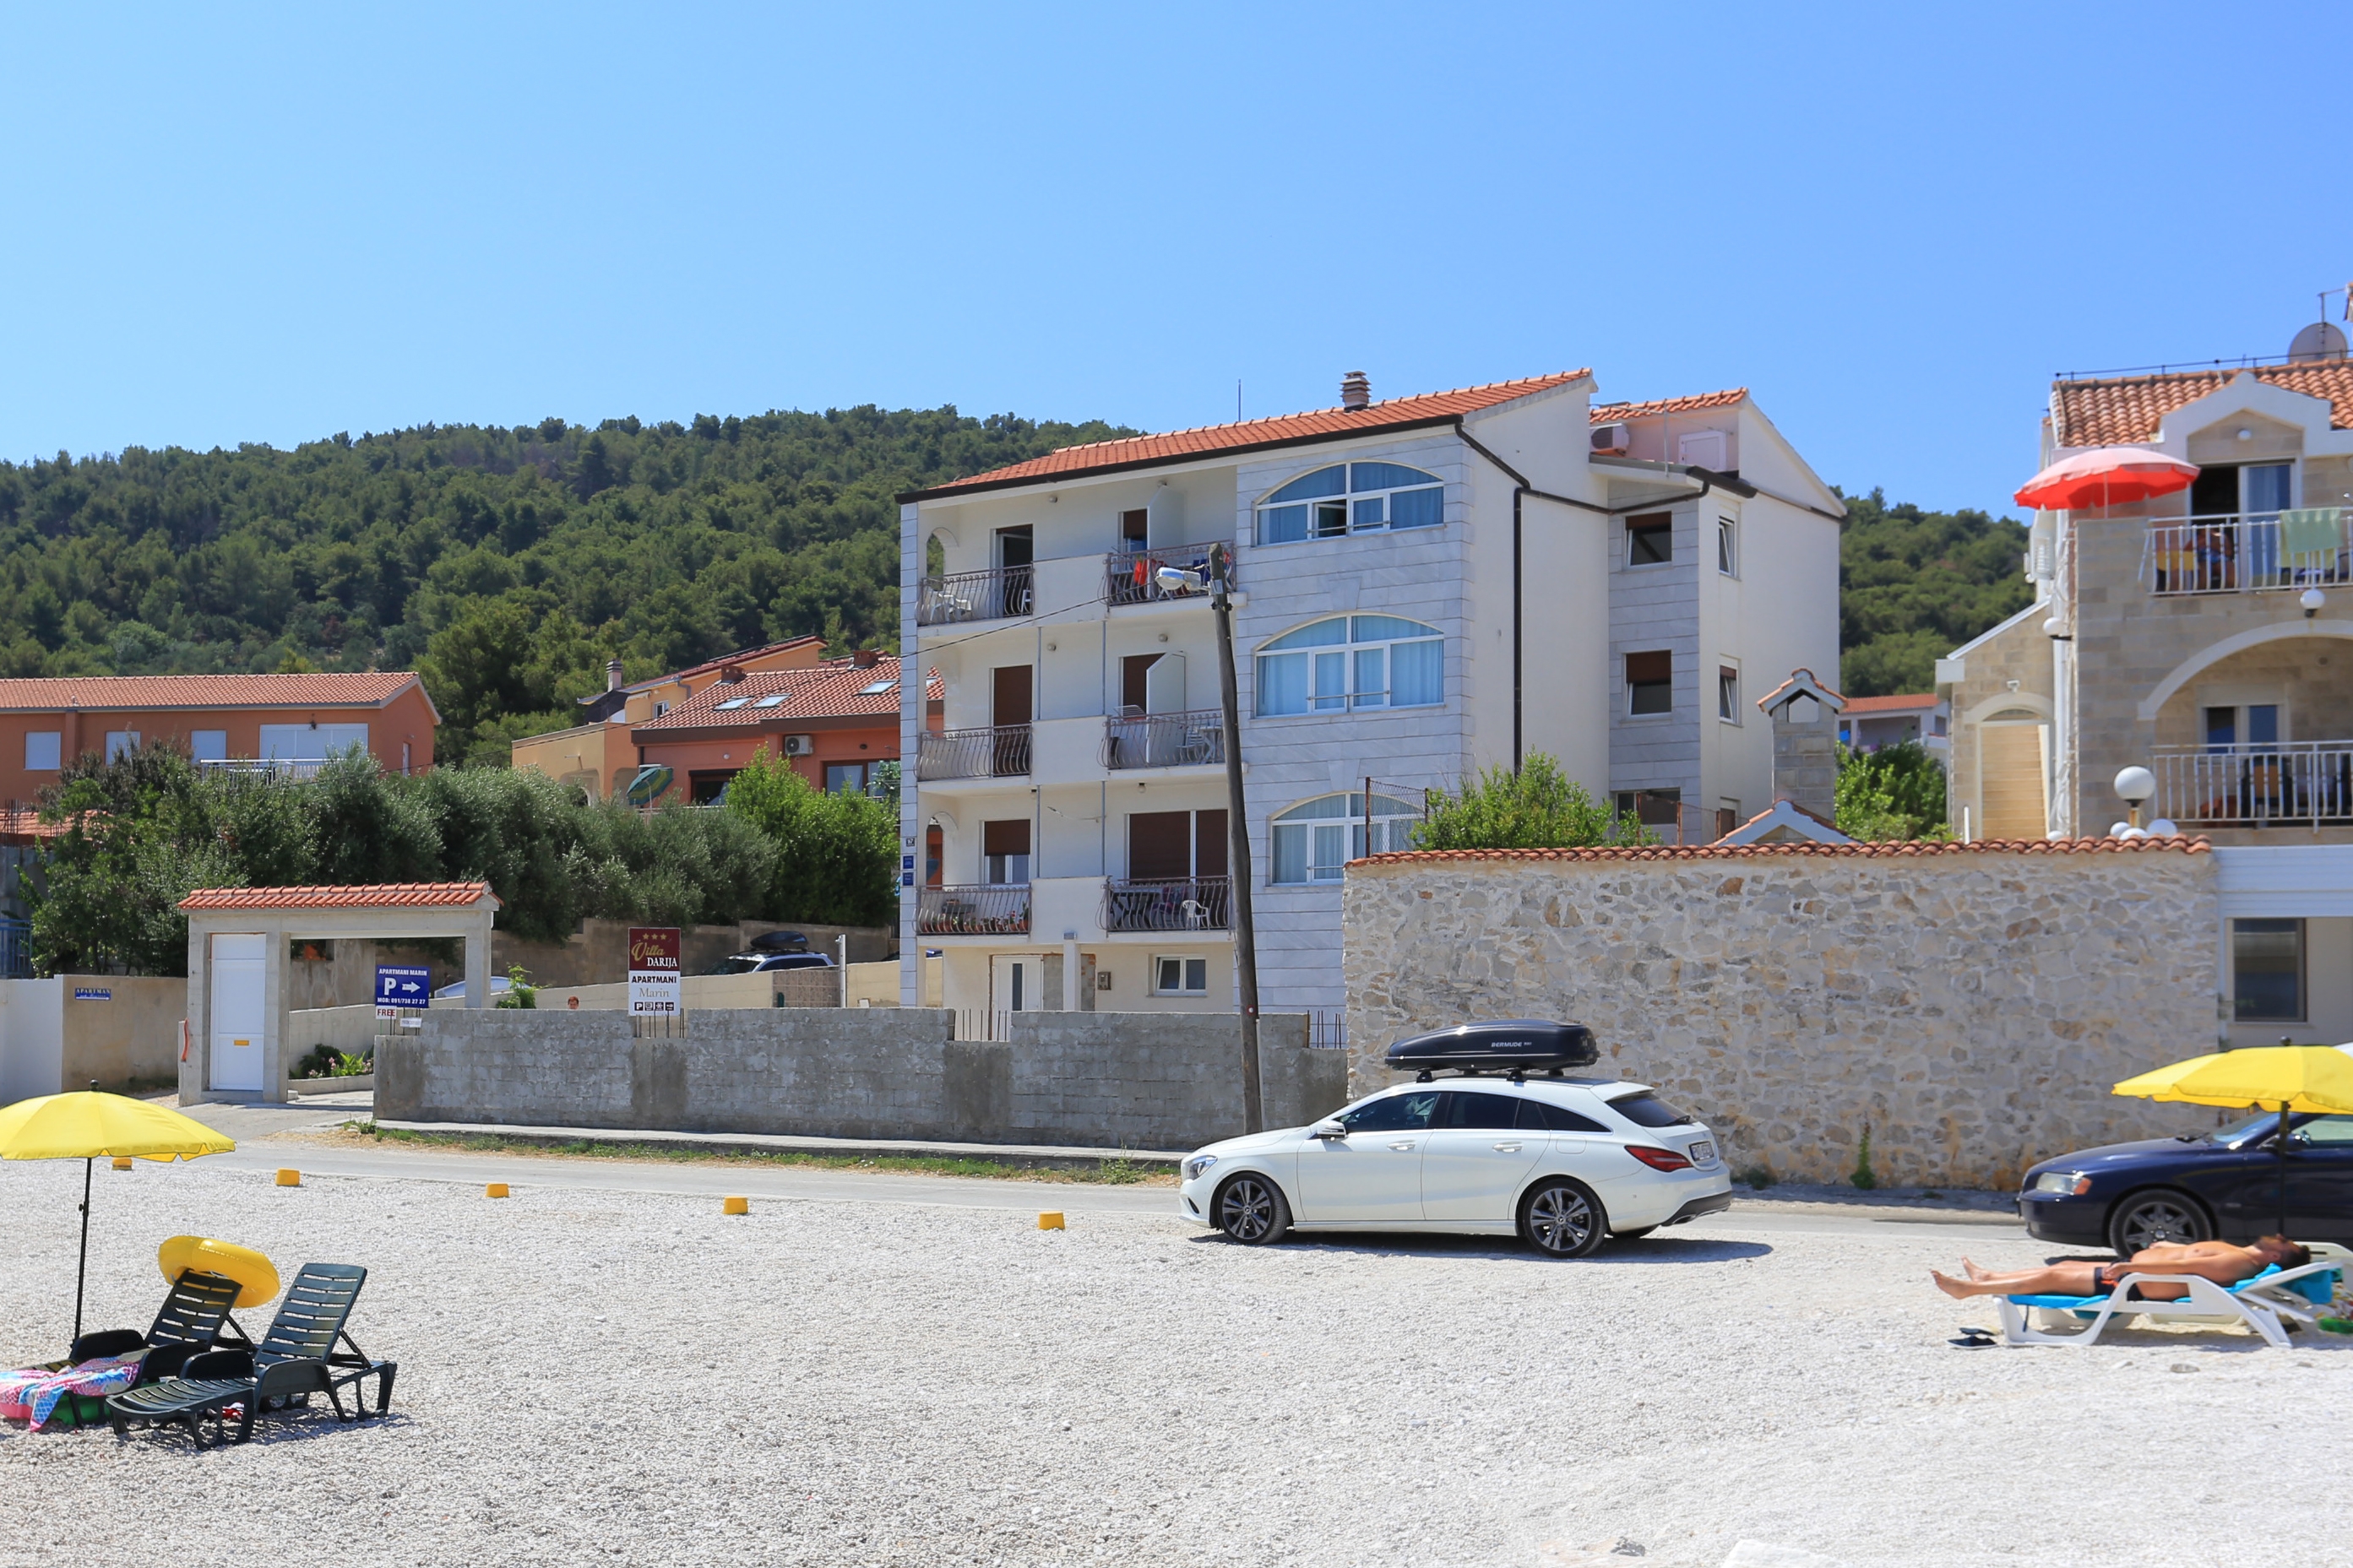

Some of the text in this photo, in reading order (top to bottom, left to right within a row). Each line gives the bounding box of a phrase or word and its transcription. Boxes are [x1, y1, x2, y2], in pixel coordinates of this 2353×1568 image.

[631, 941, 666, 962] Villa
[646, 957, 677, 968] DARIJA
[631, 975, 677, 984] APARTMANI
[383, 977, 397, 996] P
[639, 987, 670, 998] Marin
[377, 1008, 395, 1017] FREE
